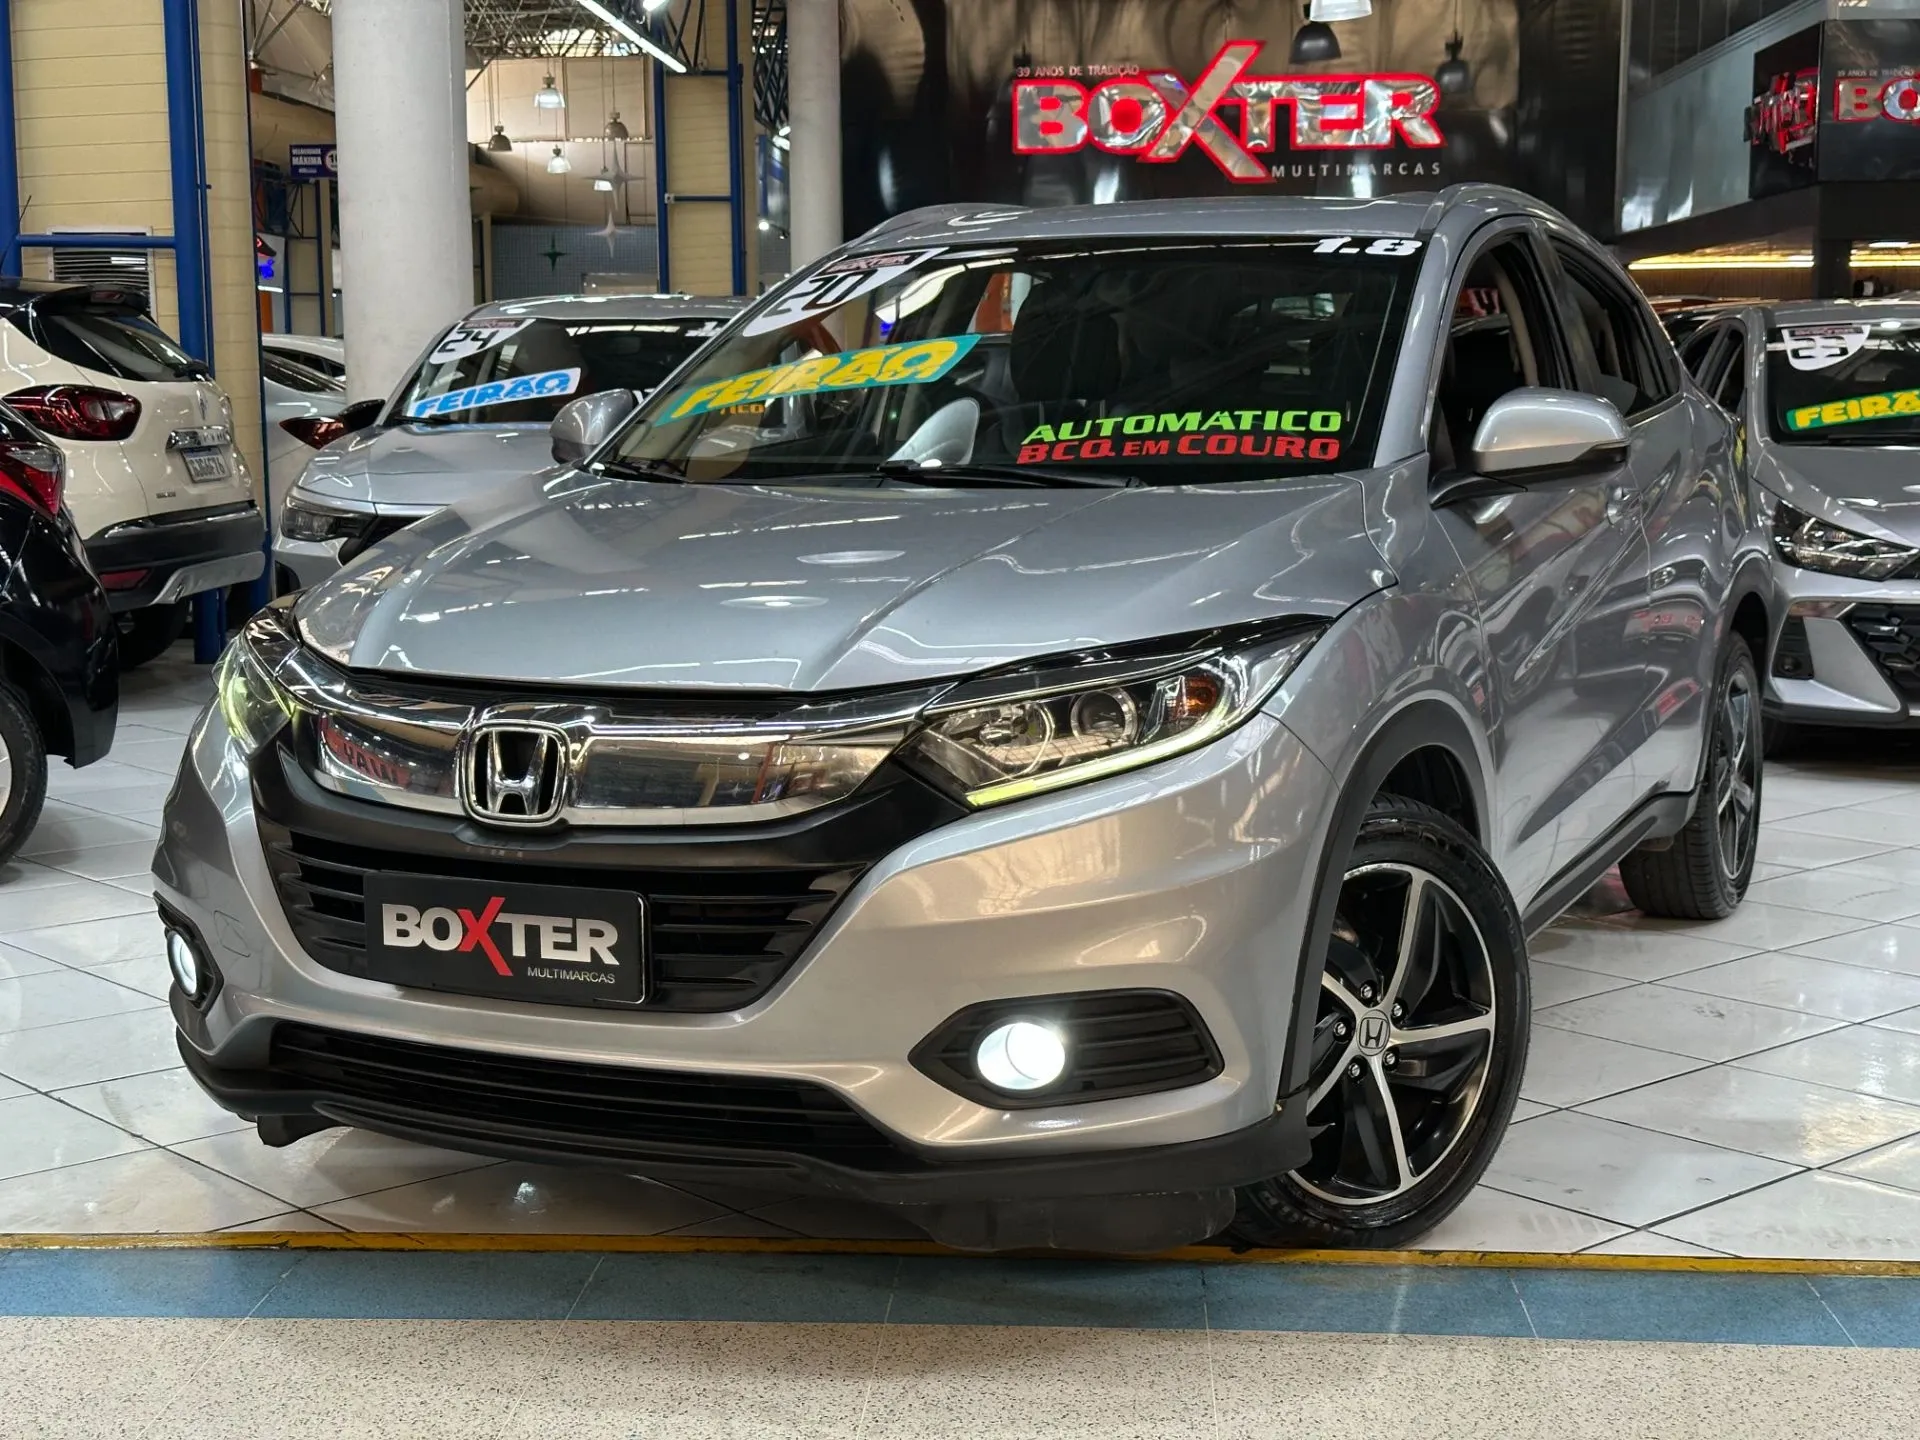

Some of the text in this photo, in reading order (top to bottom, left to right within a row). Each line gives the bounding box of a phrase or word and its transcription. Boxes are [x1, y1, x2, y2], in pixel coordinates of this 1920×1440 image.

[1017, 63, 1140, 78] 39 ANOS DE TRADIÇÃO
[1013, 40, 1447, 183] BOXTER
[1271, 162, 1442, 178] MULTIMARCAS
[1313, 236, 1423, 256] 1.8
[761, 268, 878, 319] 20
[438, 329, 500, 353] 24
[670, 340, 958, 418] FEIRÃO
[414, 371, 571, 419] FEIRÃO
[1121, 440, 1170, 457] EM
[1176, 434, 1340, 461] COURO
[382, 896, 621, 977] BOXTER
[526, 966, 616, 984] MULTIMARCAS
